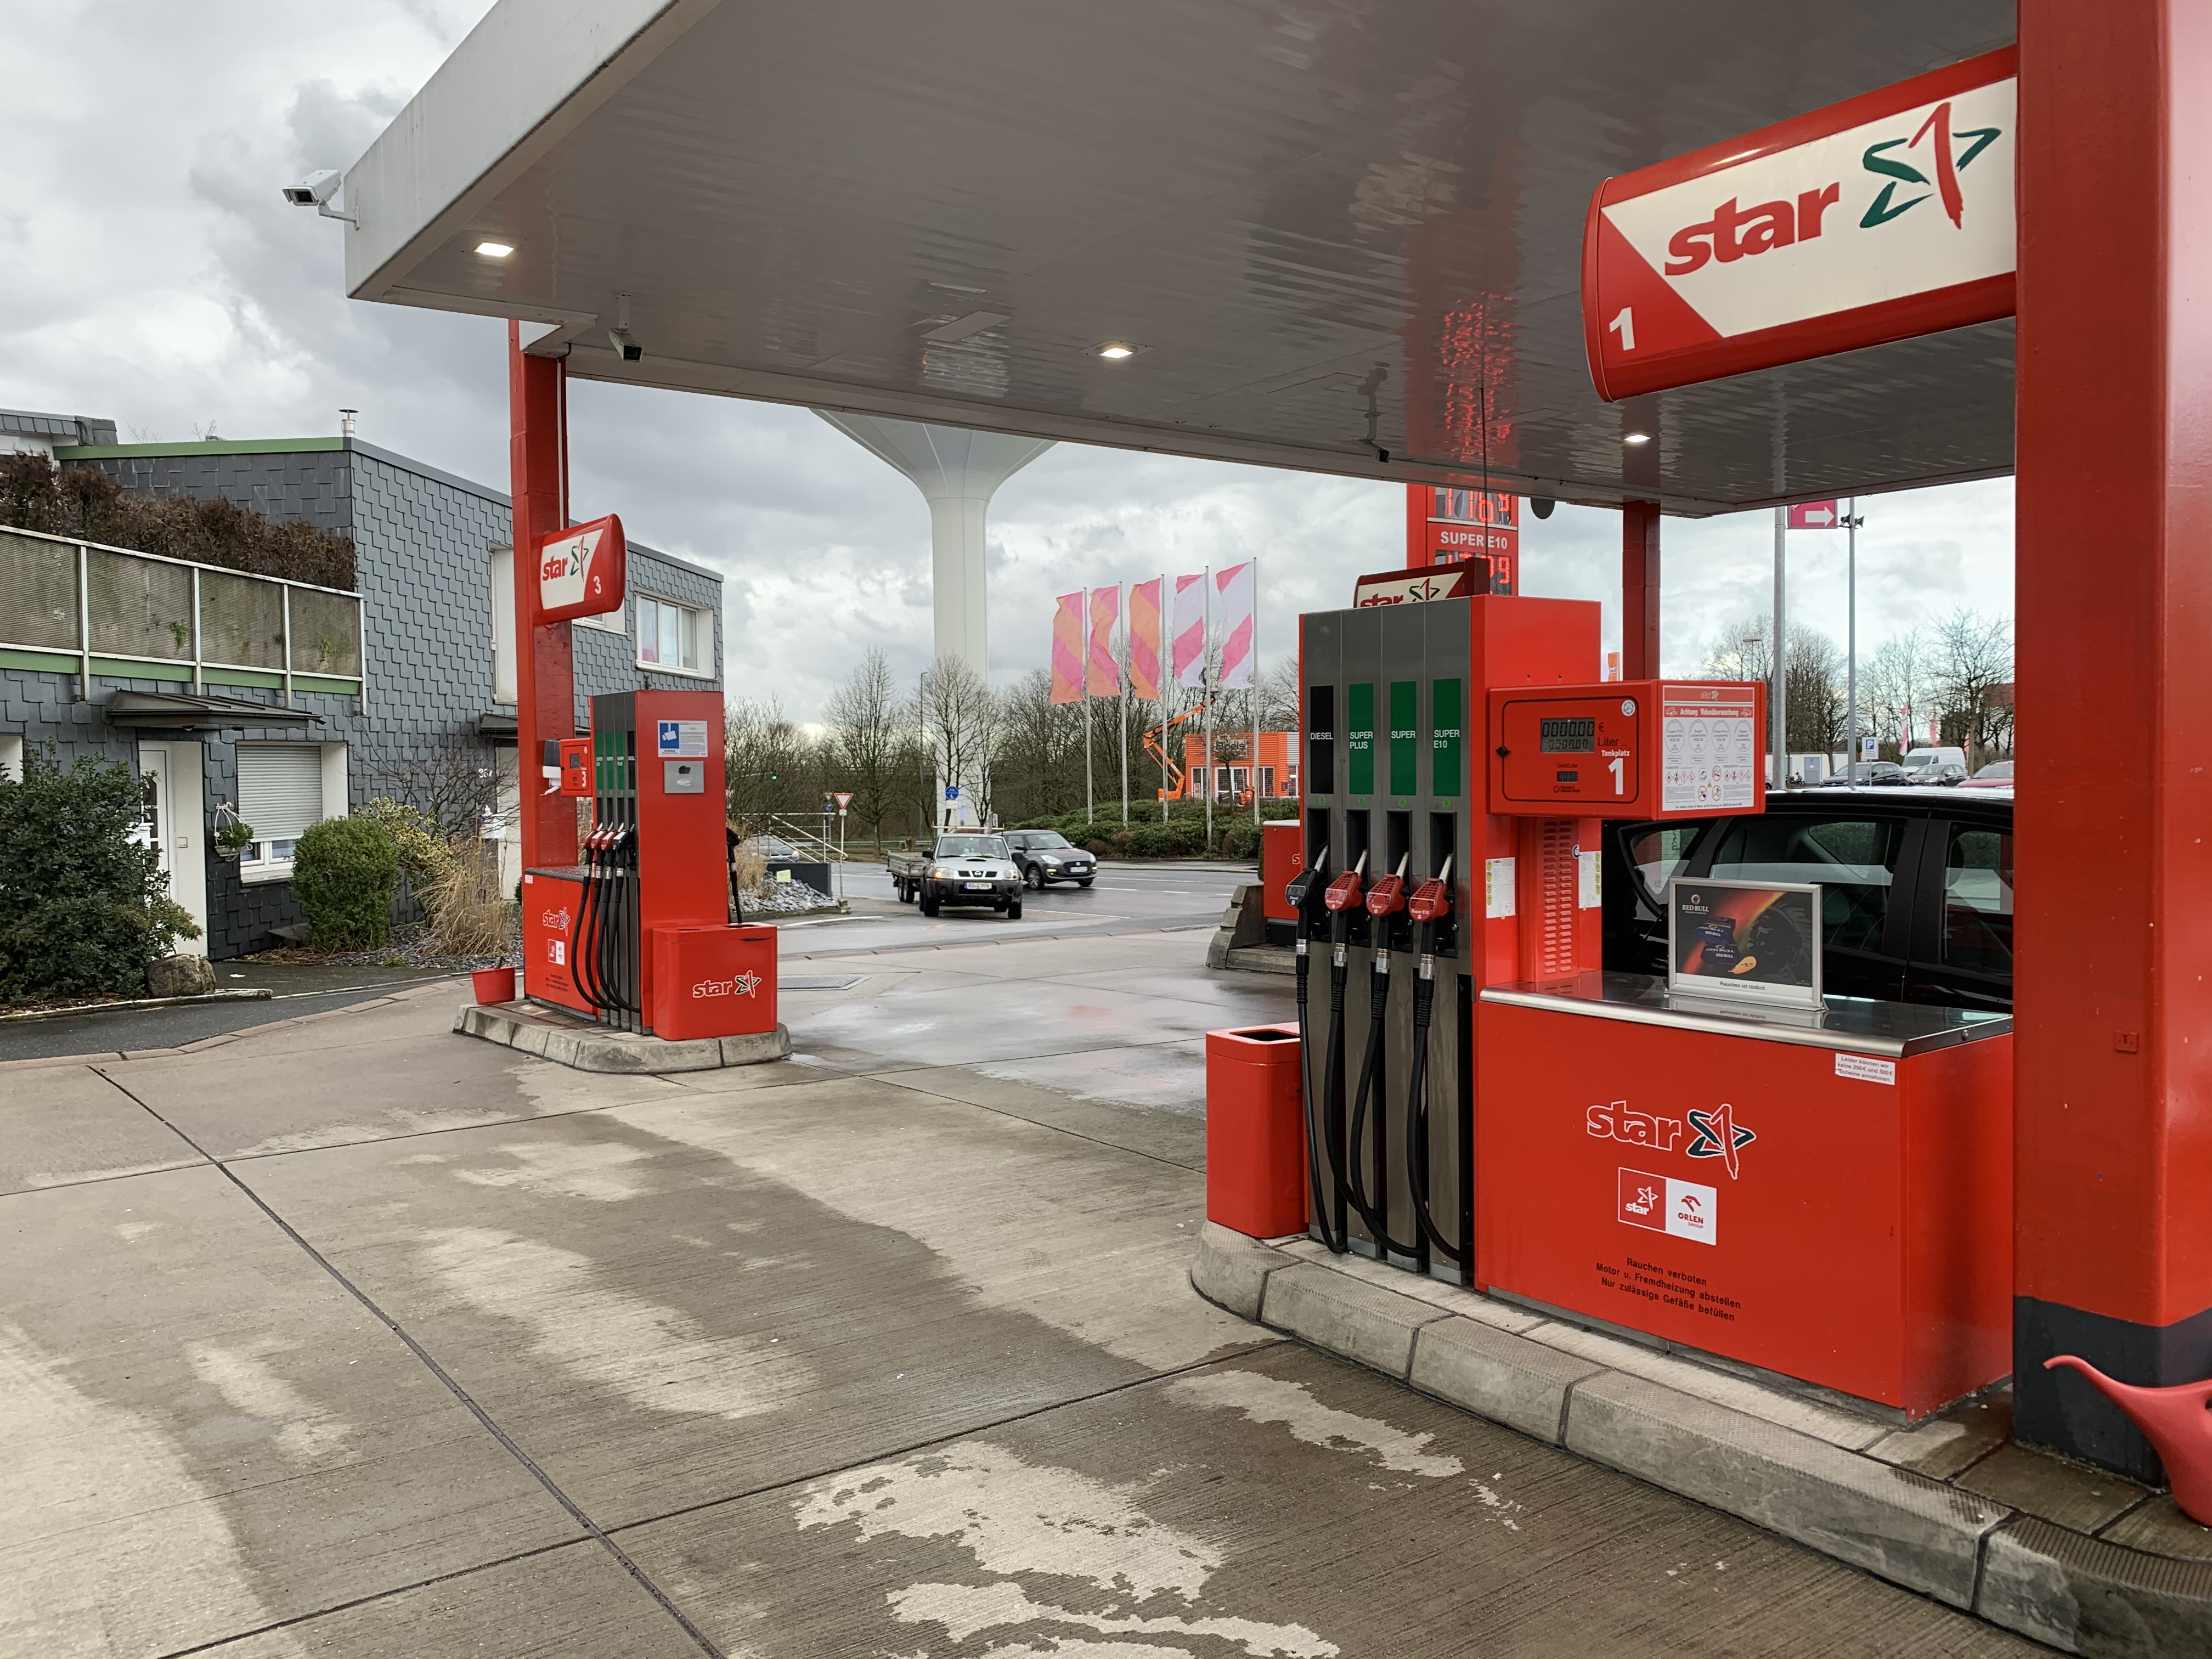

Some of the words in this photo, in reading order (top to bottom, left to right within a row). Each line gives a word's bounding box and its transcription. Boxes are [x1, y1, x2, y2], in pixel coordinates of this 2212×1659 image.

[1664, 182, 1839, 276] star
[1609, 307, 1636, 351] 1
[1441, 531, 1484, 547] SUPER
[1487, 535, 1508, 549] E10
[543, 555, 568, 581] star
[594, 575, 601, 594] 3
[1680, 708, 1698, 716] Achtung
[1350, 731, 1373, 740] SUPER
[1391, 730, 1415, 739] SUPER
[1434, 729, 1460, 738] SUPER
[1598, 722, 1605, 732] €
[1310, 732, 1334, 740] DIESEL
[1434, 740, 1447, 748] E10
[1598, 737, 1620, 747] Liter
[1350, 741, 1368, 749] PLUS
[1601, 749, 1630, 758] Tankplatz
[582, 770, 586, 787] 3
[1608, 758, 1624, 795] 1
[543, 910, 558, 928] star
[693, 980, 732, 998] star
[1587, 1101, 1681, 1151] star
[1626, 1203, 1649, 1215] star
[1678, 1212, 1703, 1224] ORLEN
[1627, 1257, 1663, 1274] Rauchen
[1668, 1269, 1707, 1286] verboten
[1596, 1262, 1620, 1276] Motor
[1635, 1273, 1695, 1299] Fremdheizung
[1700, 1291, 1741, 1309] abstellen
[1601, 1277, 1615, 1288] Nur
[1619, 1284, 1659, 1301] zulässige
[1663, 1294, 1694, 1310] Gefäße
[1699, 1304, 1735, 1321] befüllen
